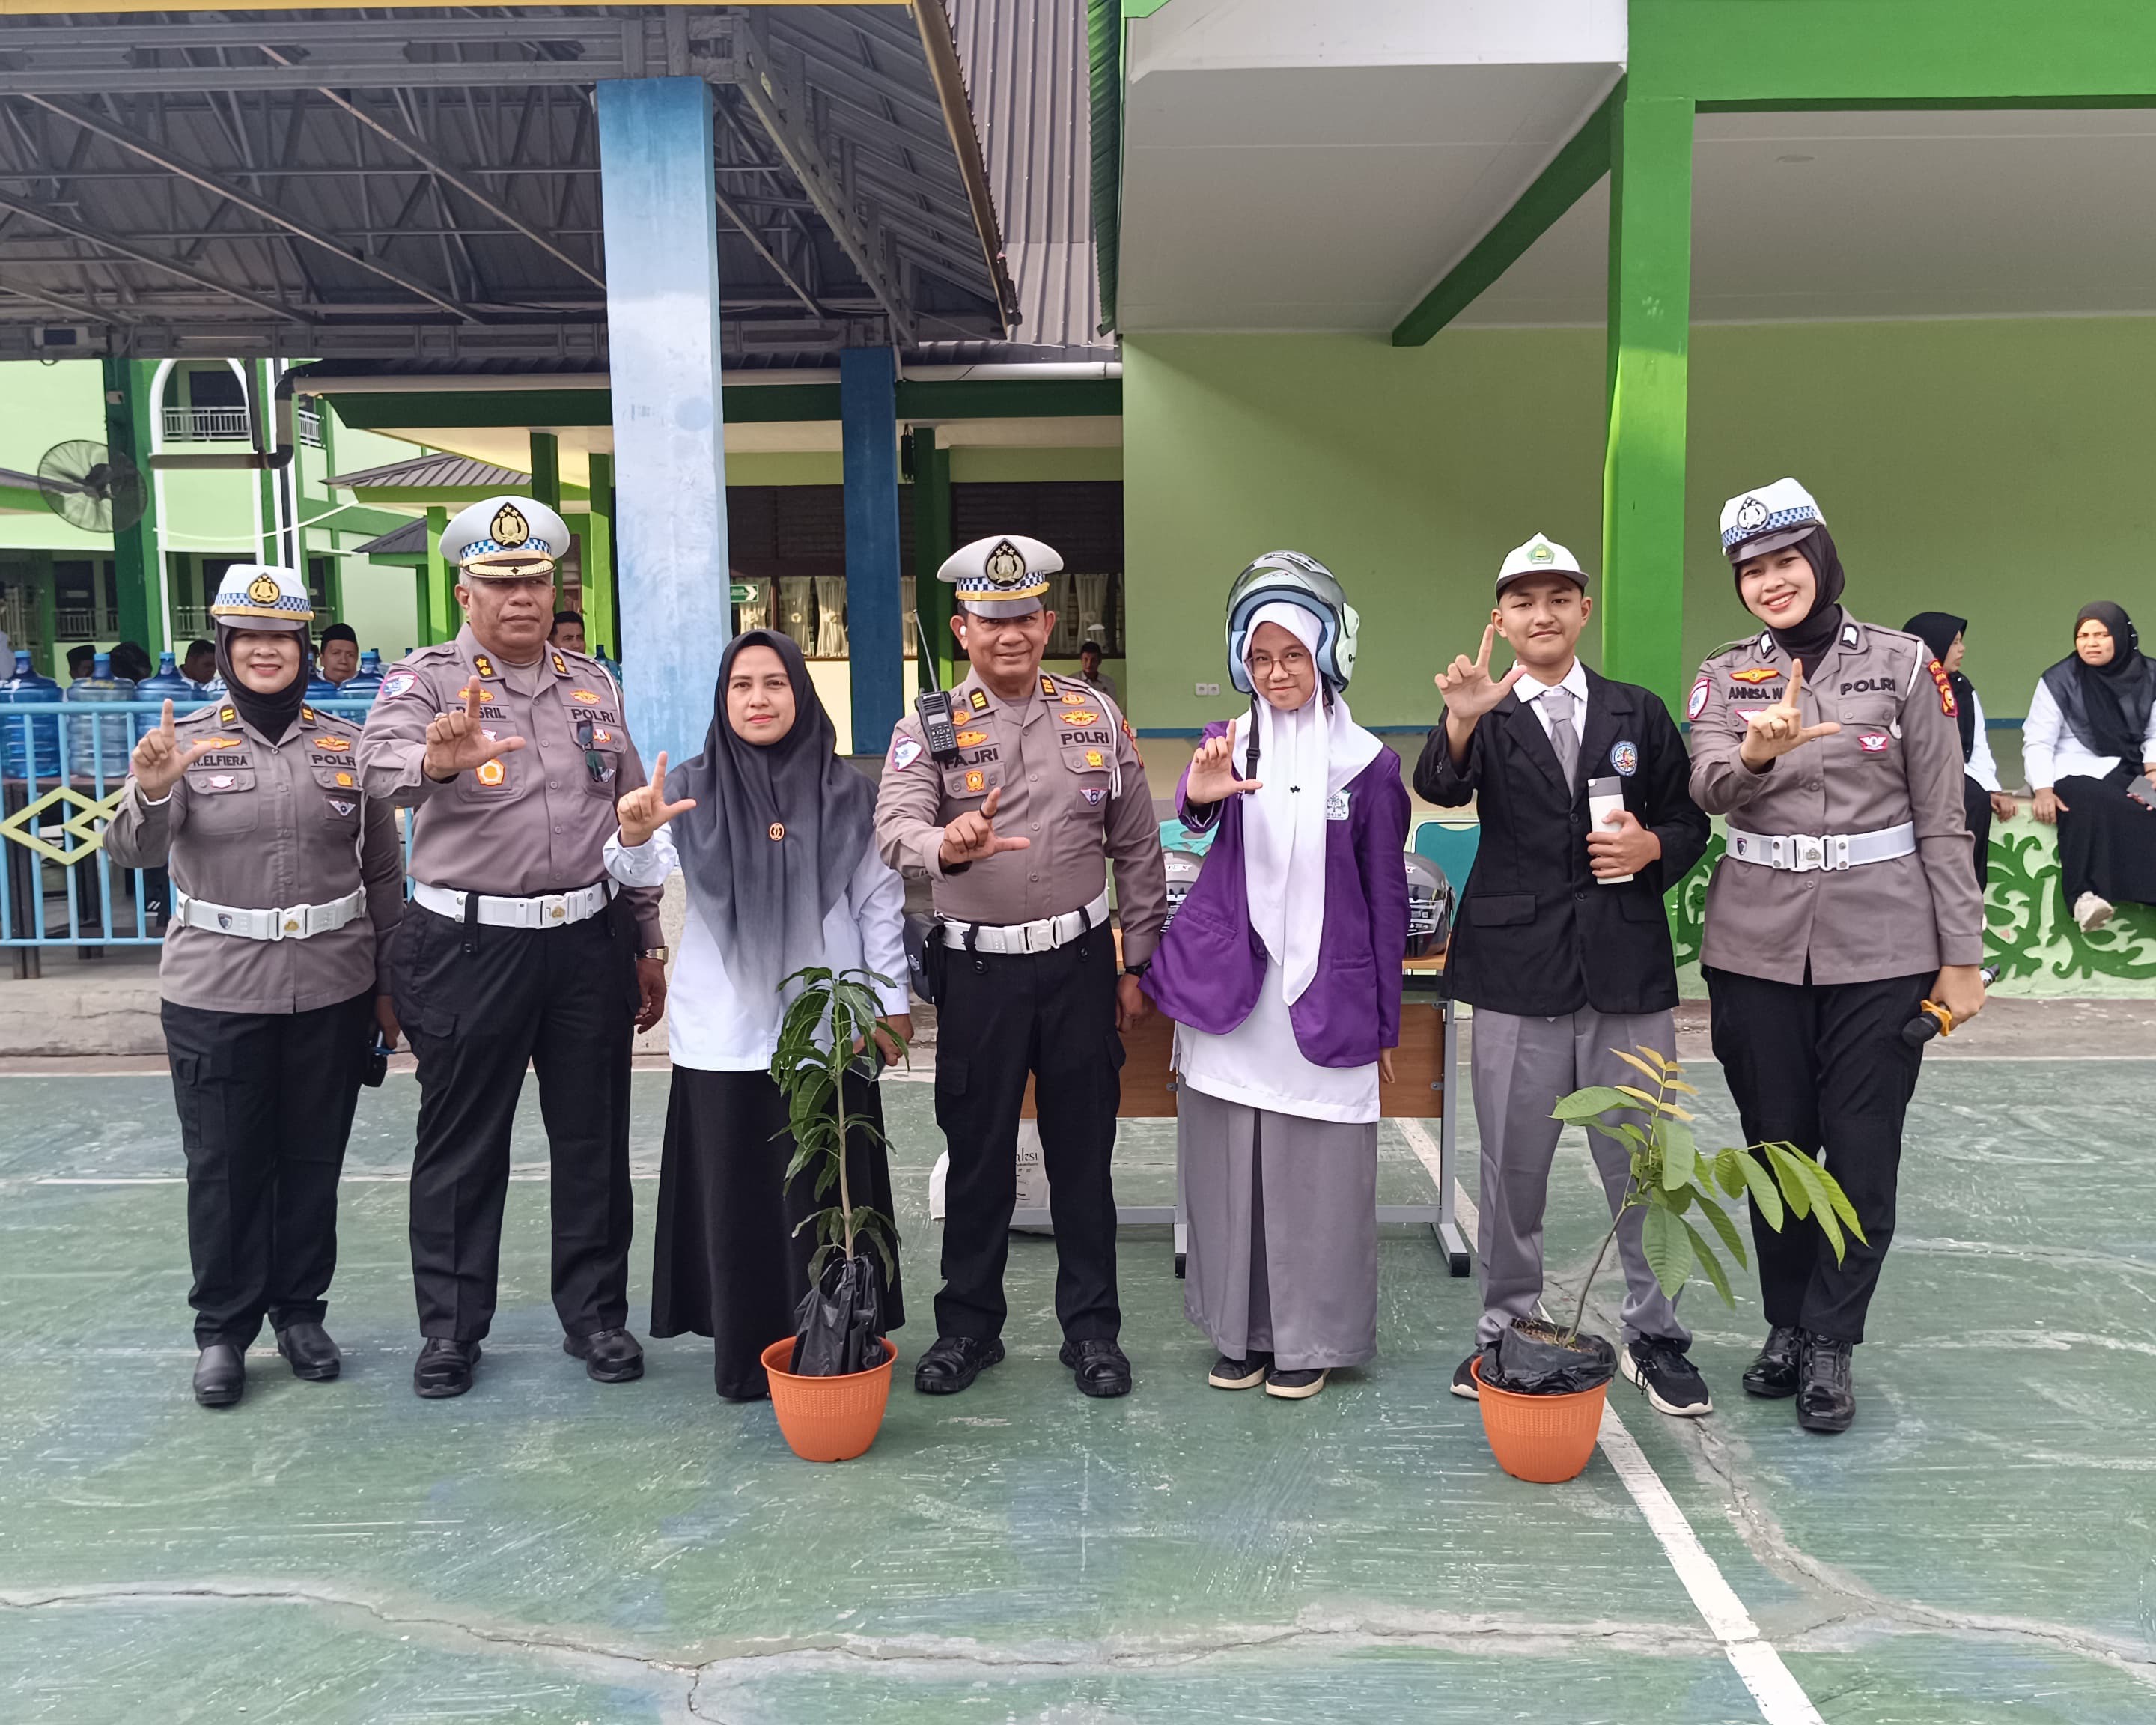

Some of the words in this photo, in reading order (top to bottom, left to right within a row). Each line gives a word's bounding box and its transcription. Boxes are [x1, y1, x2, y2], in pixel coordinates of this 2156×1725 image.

[1840, 678, 1896, 696] POLRI
[571, 708, 615, 723] POLRI
[1061, 731, 1109, 746] POLRI
[311, 754, 356, 767] POLR
[944, 748, 999, 770] FAJRI
